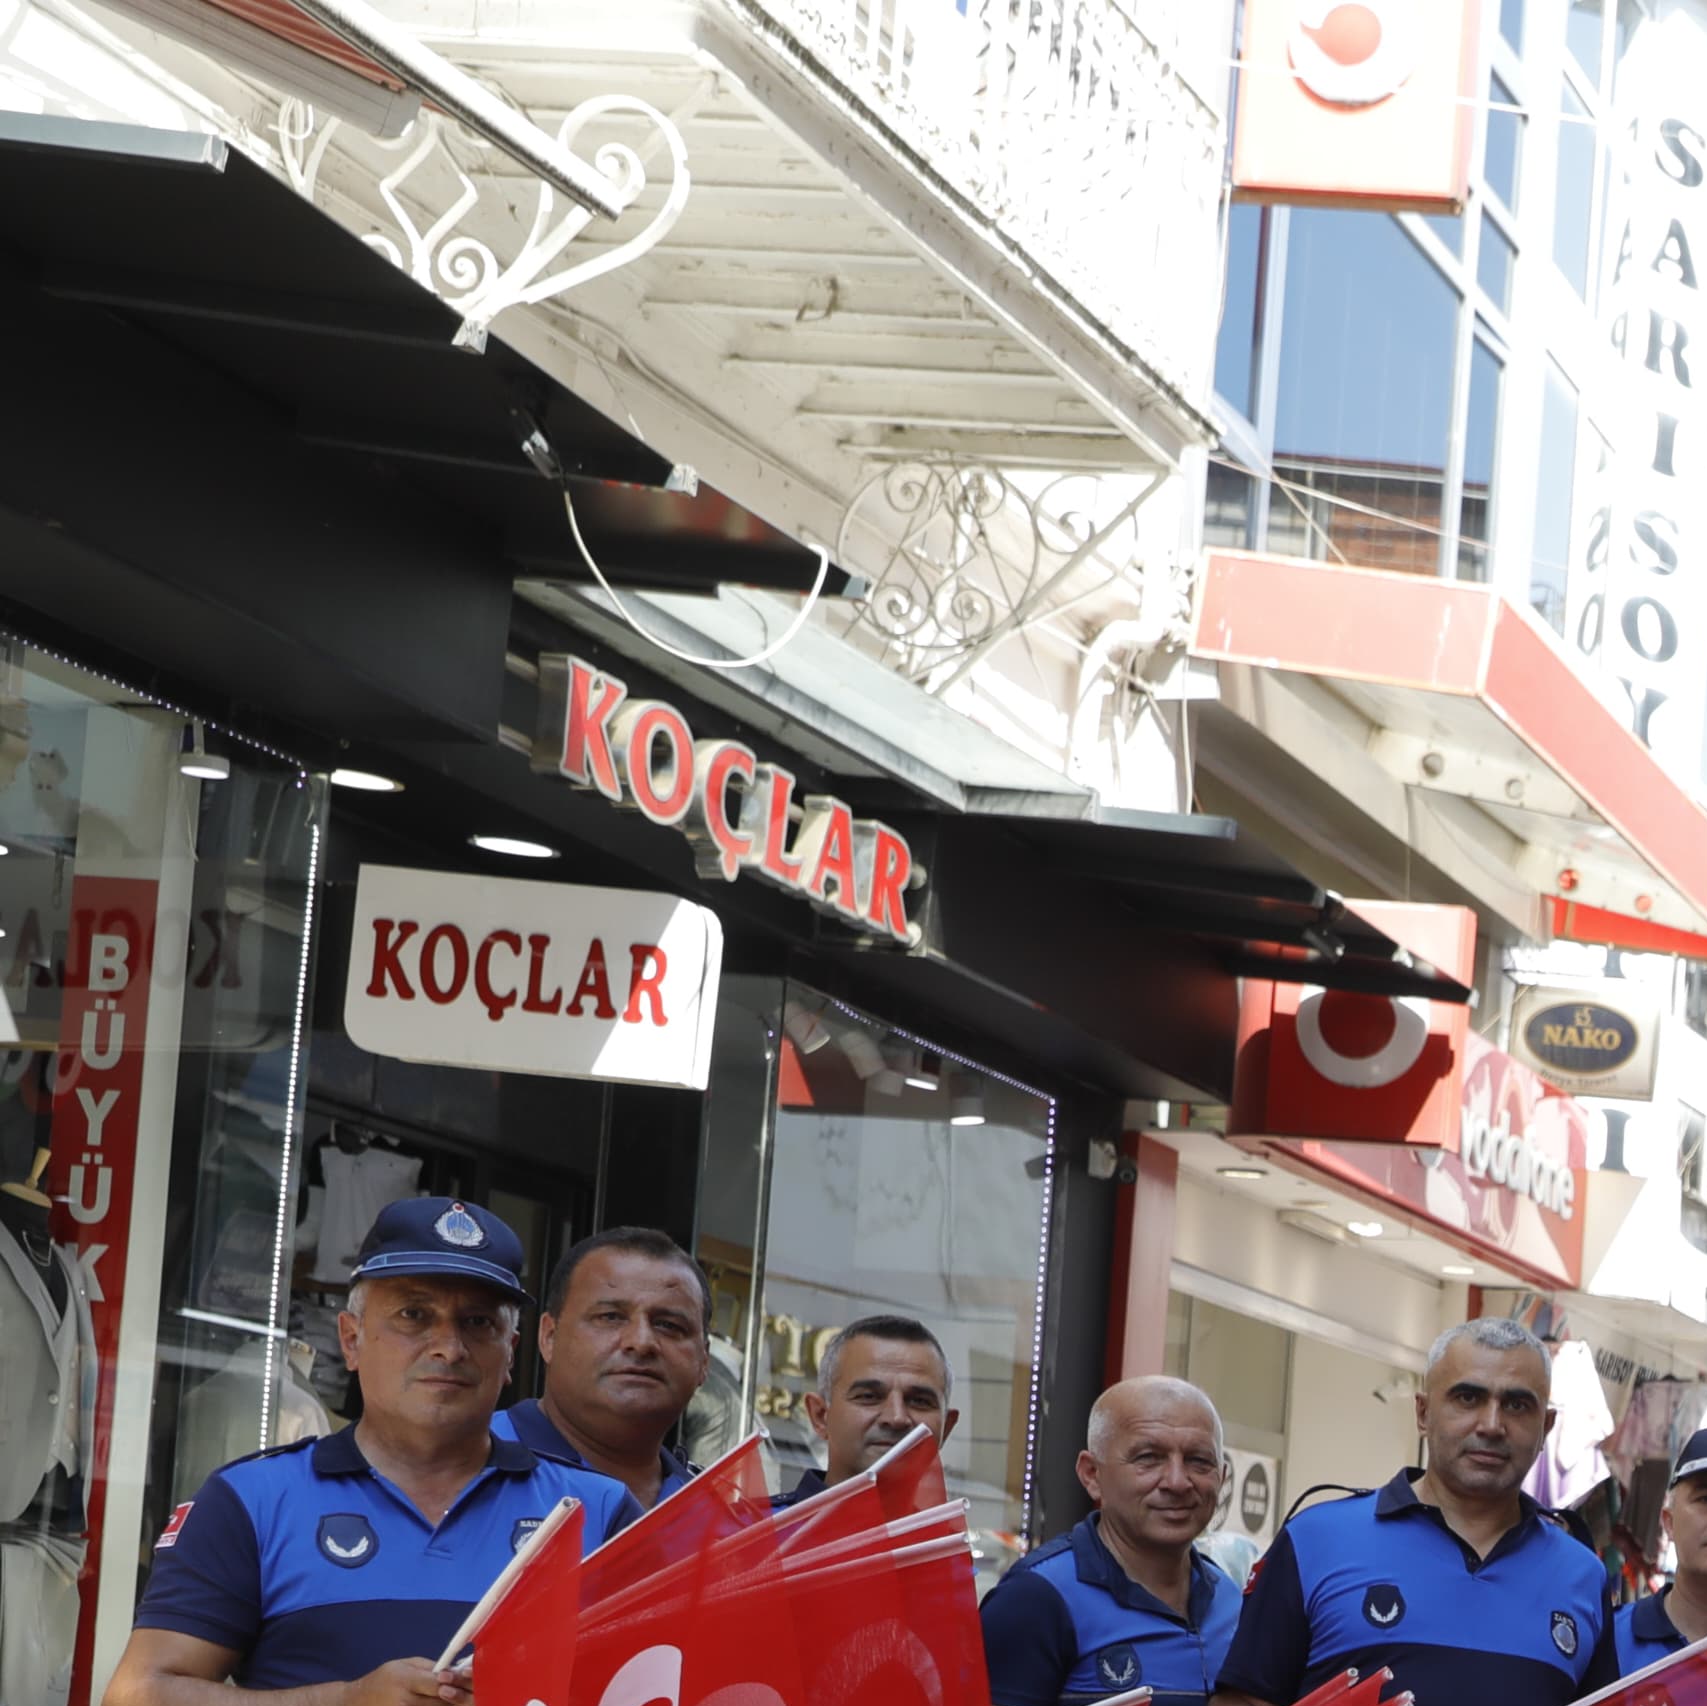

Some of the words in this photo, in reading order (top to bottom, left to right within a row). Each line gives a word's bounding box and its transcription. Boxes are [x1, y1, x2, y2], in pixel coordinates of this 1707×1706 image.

[1616, 117, 1707, 751] SARISOY
[558, 655, 914, 944] KOÇLAR
[366, 917, 671, 1028] KOÇLAR
[1542, 1023, 1622, 1051] NAKO
[64, 933, 130, 1303] BÜYÜK
[1460, 1106, 1576, 1221] vodafone
[519, 1519, 543, 1528] ZAB
